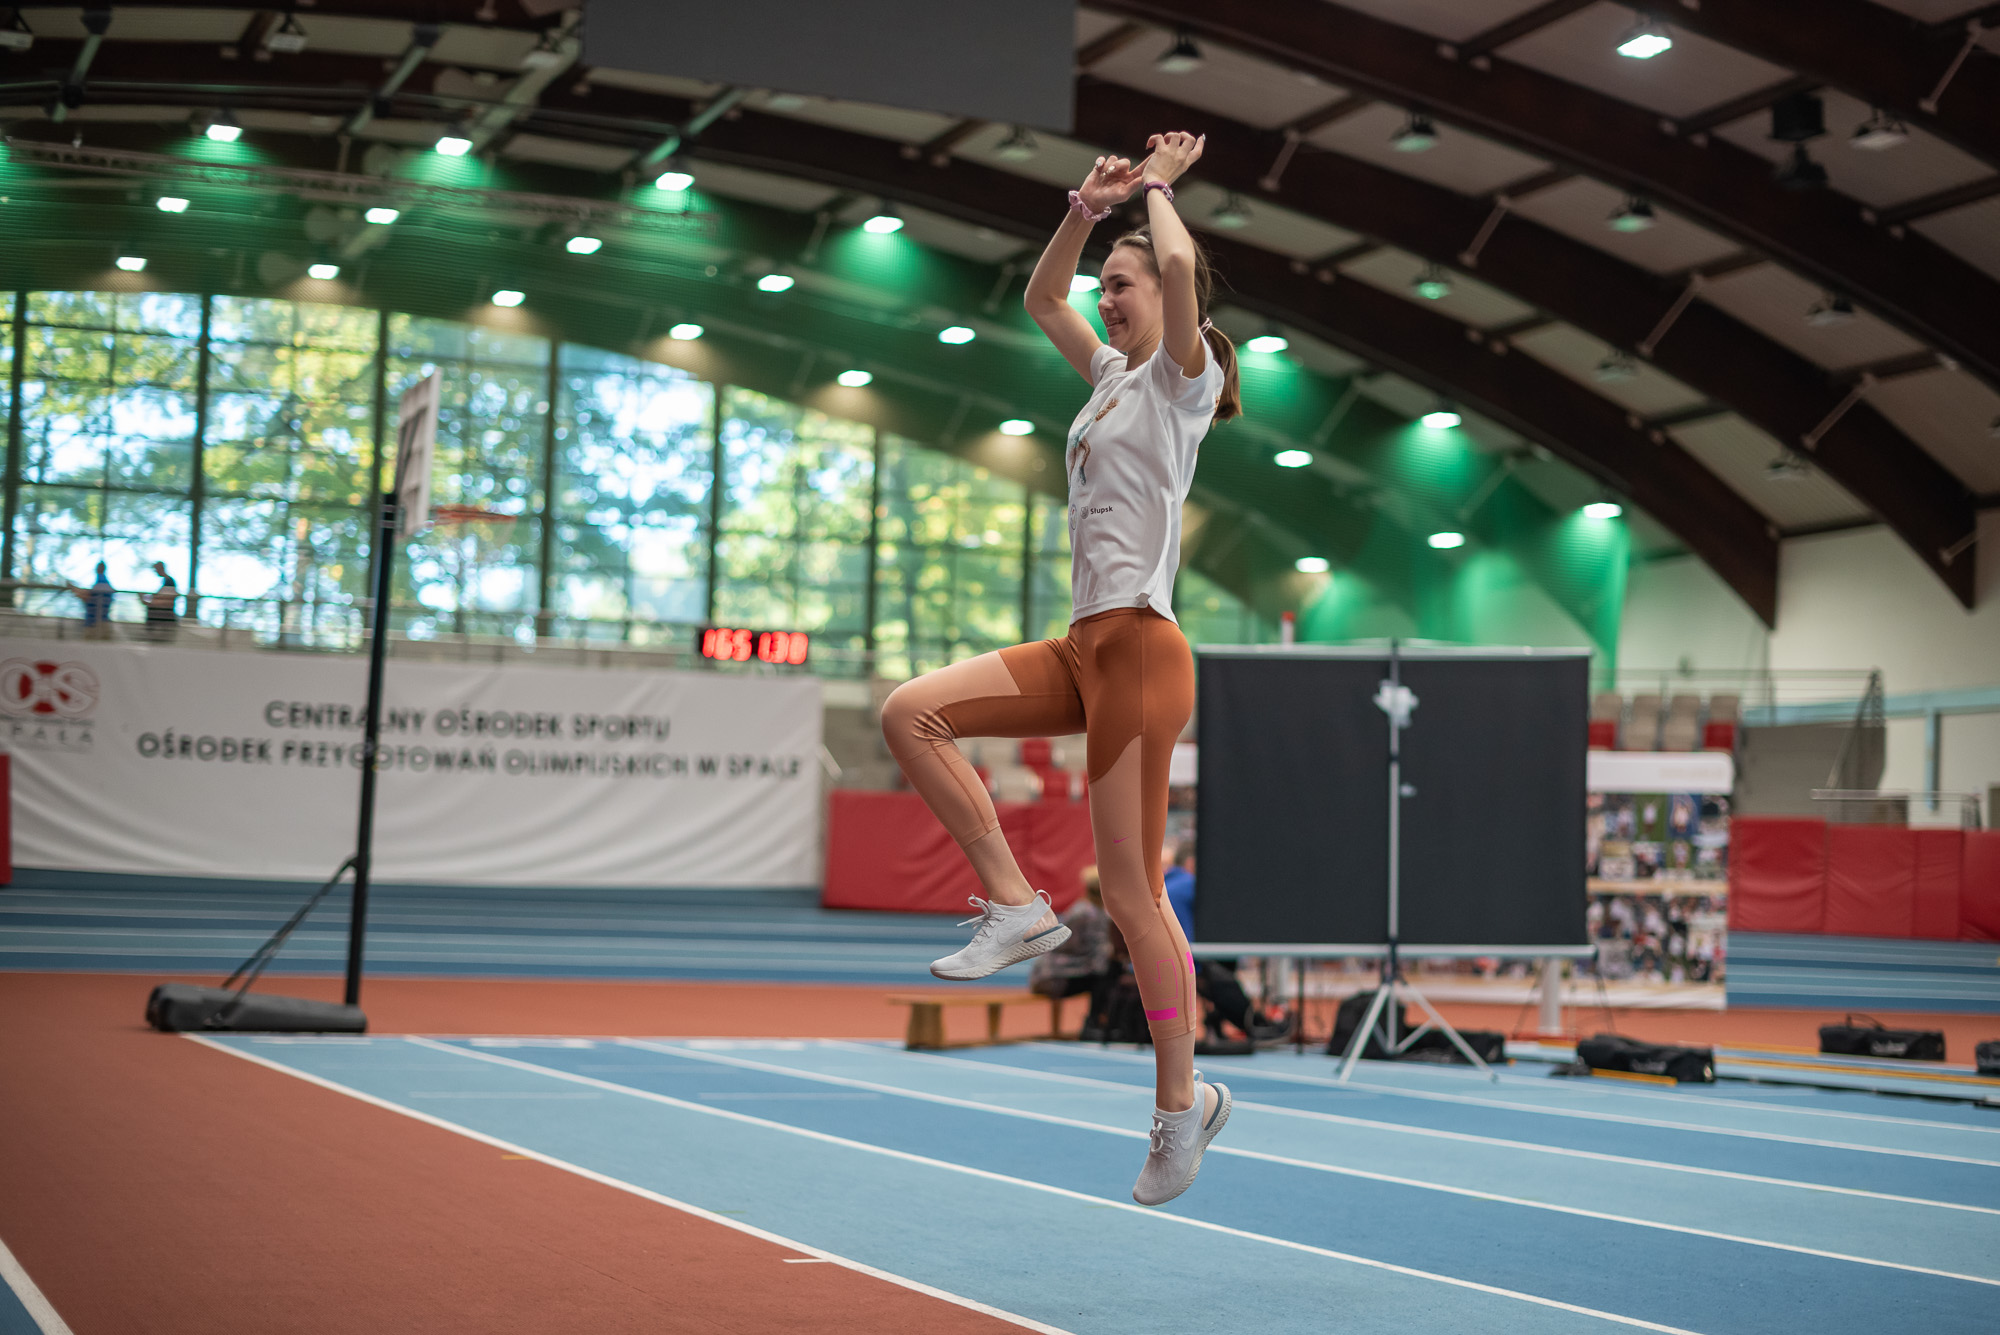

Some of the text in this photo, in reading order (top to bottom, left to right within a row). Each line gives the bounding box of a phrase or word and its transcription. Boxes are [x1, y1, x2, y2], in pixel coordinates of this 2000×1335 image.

[433, 707, 562, 741] OŚRODEK
[571, 713, 671, 744] SPORTU
[136, 728, 272, 766] OŚRODEK
[697, 755, 721, 777] W
